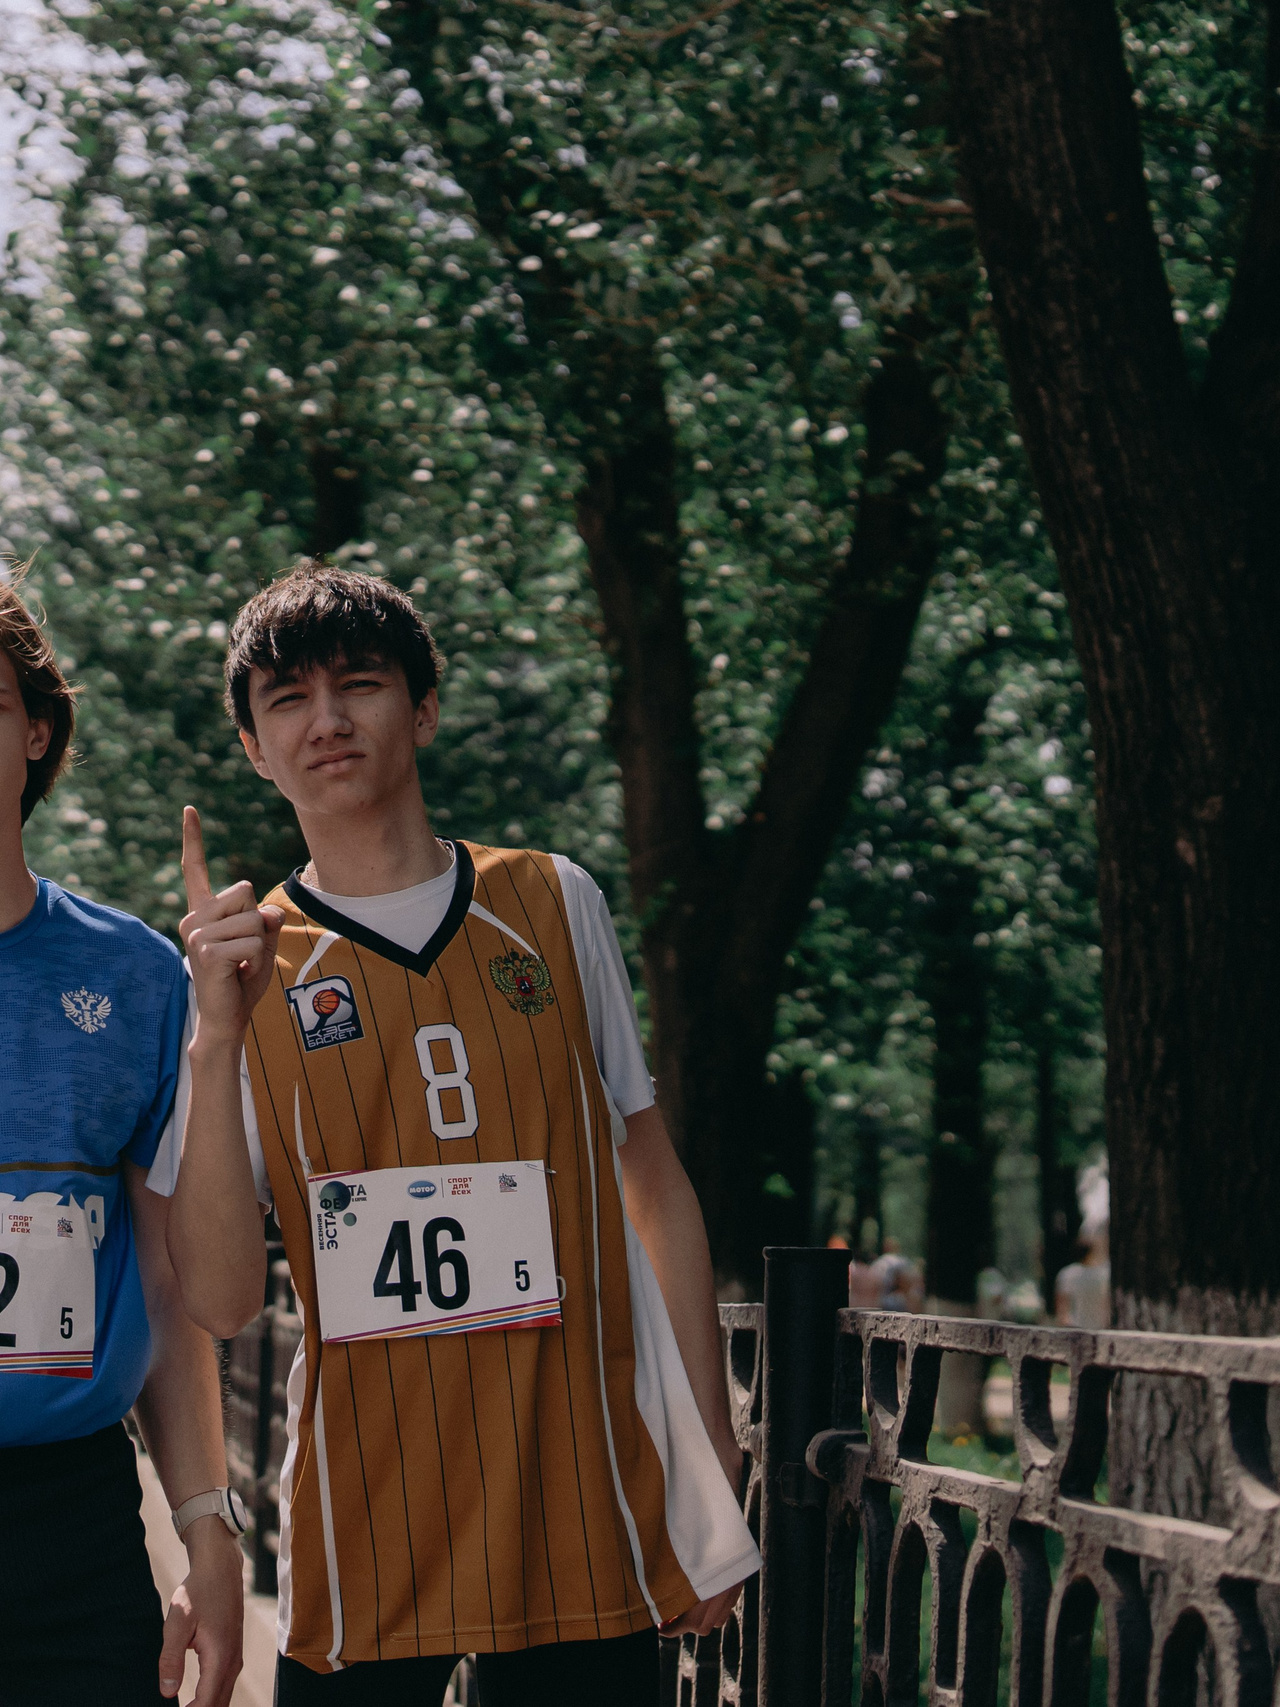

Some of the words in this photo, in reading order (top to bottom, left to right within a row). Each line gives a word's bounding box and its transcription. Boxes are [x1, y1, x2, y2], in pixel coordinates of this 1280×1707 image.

[413, 1023, 479, 1141] 8
[409, 1185, 435, 1194] МОТОР
[372, 1216, 471, 1313] 46
[514, 1259, 531, 1292] 5
[60, 1306, 73, 1340] 5
